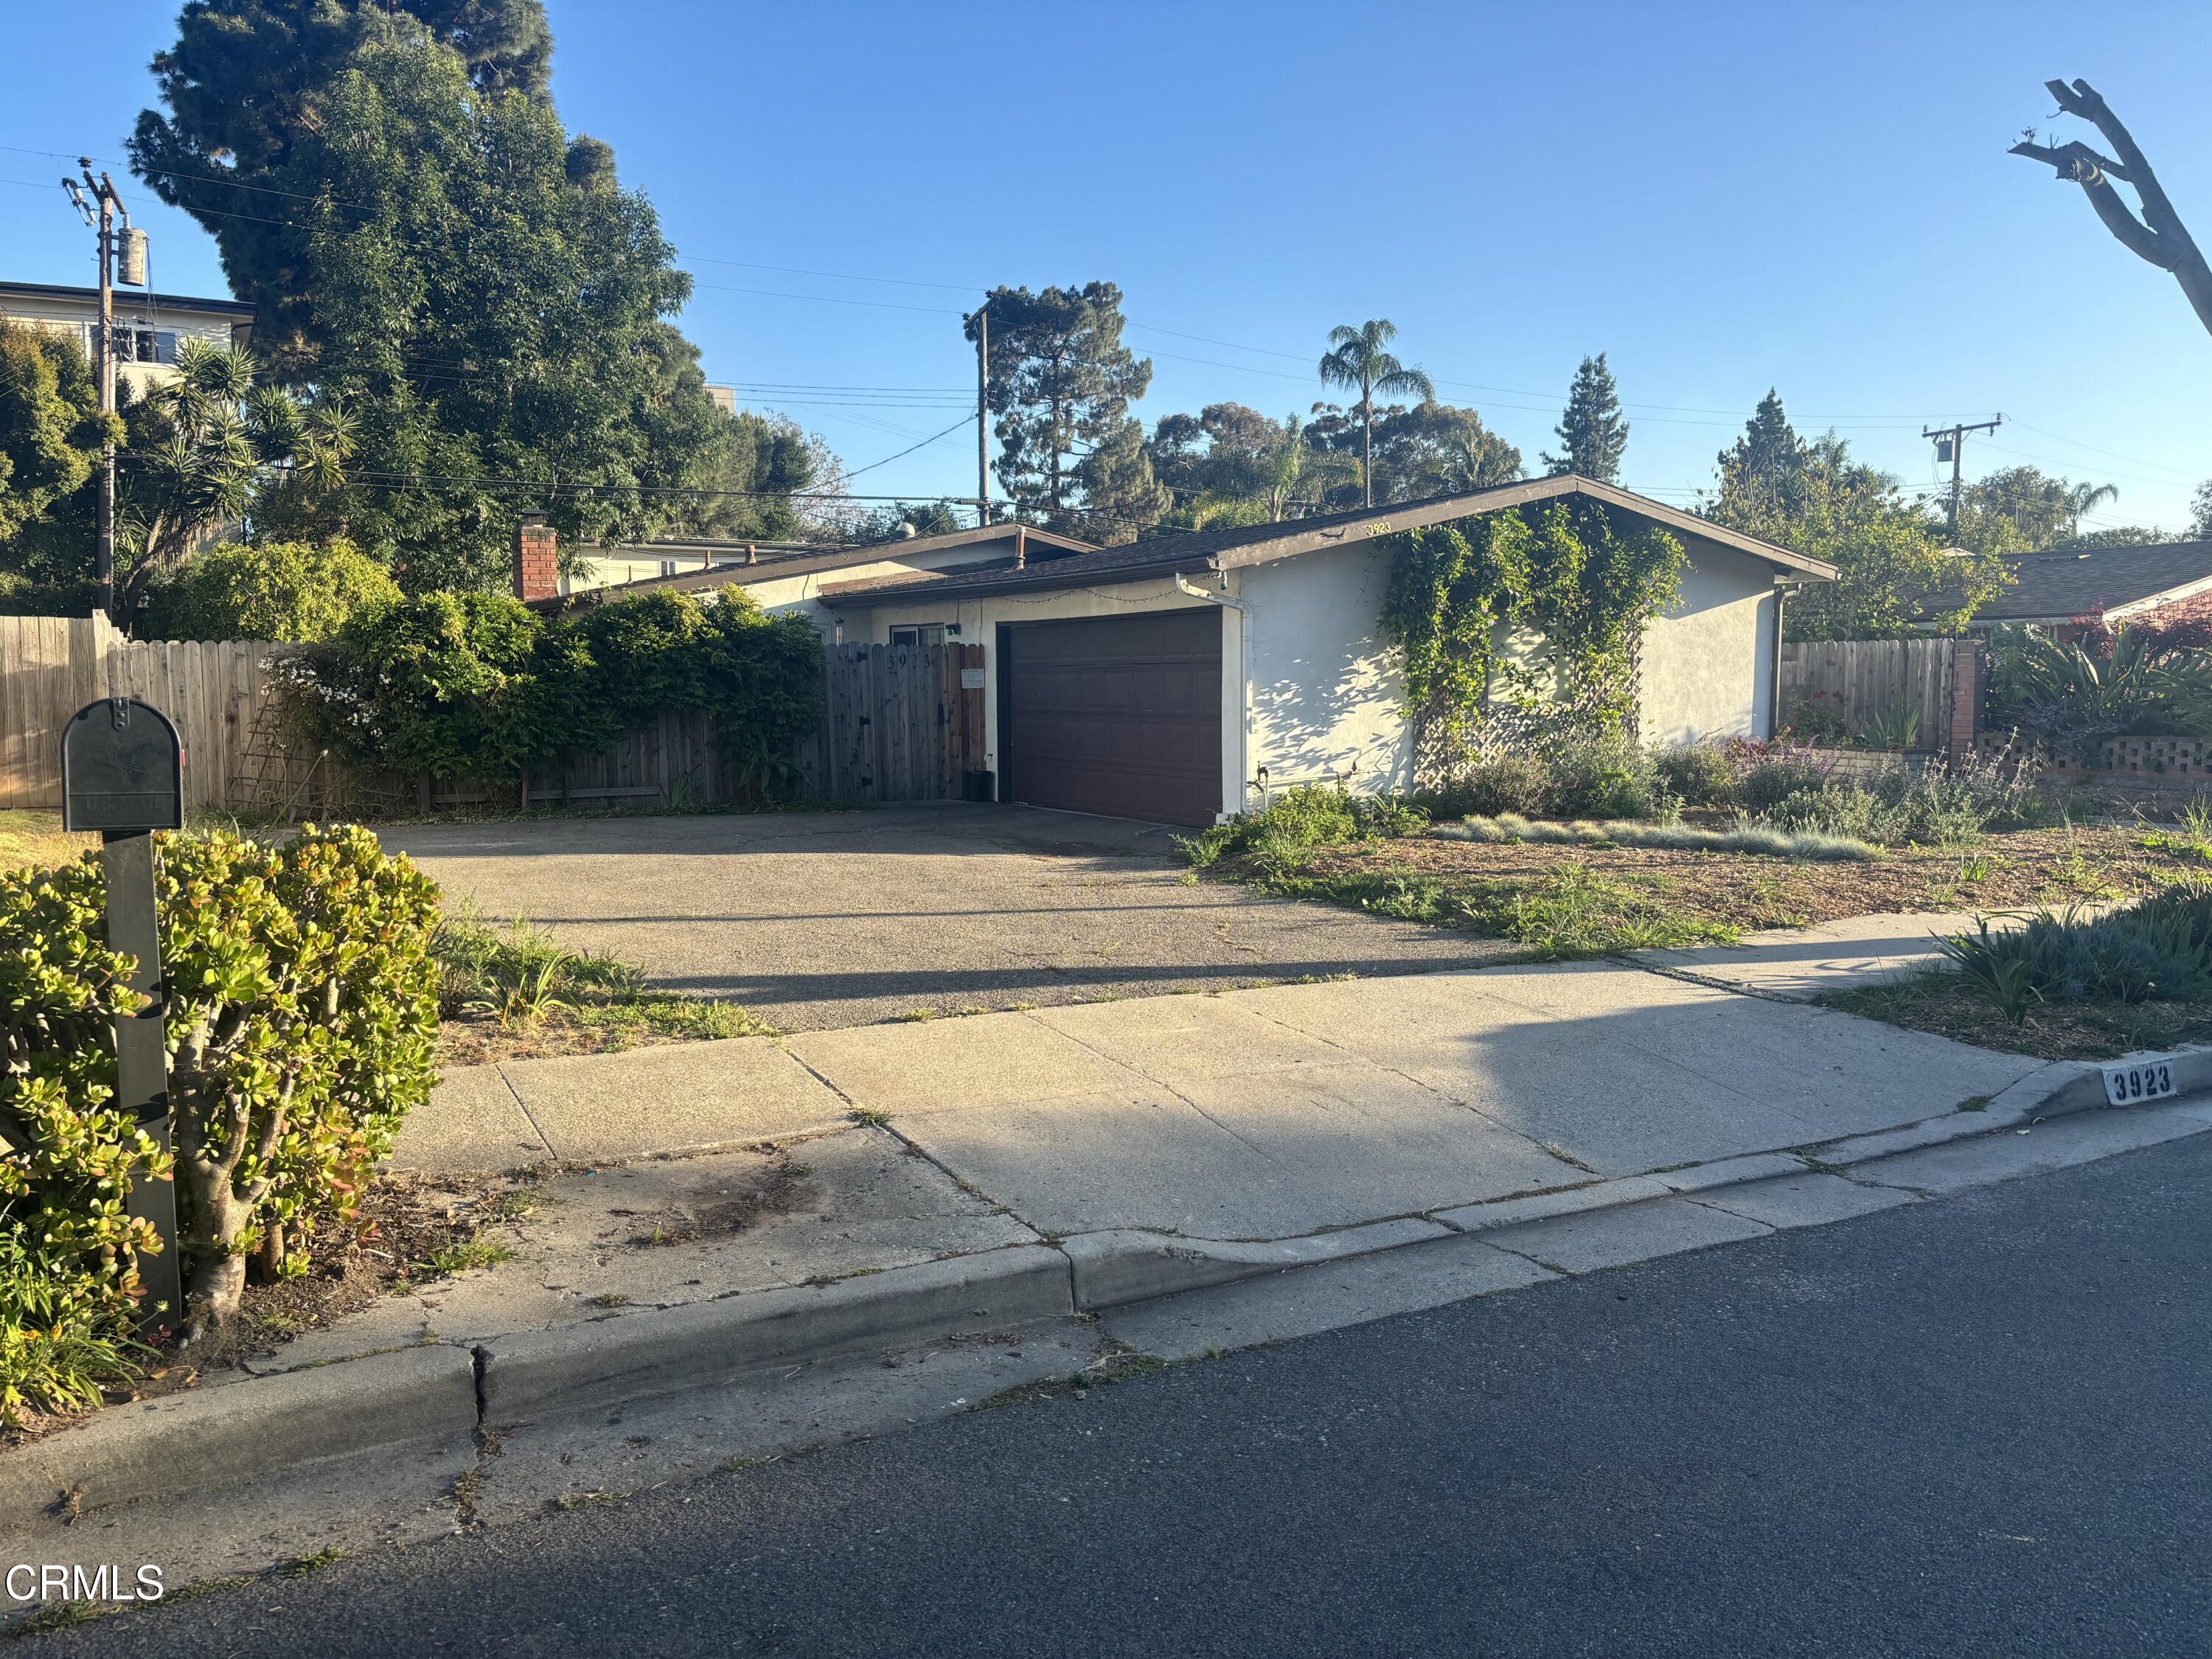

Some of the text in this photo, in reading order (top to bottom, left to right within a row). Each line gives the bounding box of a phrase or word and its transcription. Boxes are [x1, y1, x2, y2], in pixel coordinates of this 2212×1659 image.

[1368, 522, 1391, 535] 3923
[118, 795, 161, 810] MAIL
[2114, 1065, 2170, 1101] 3923
